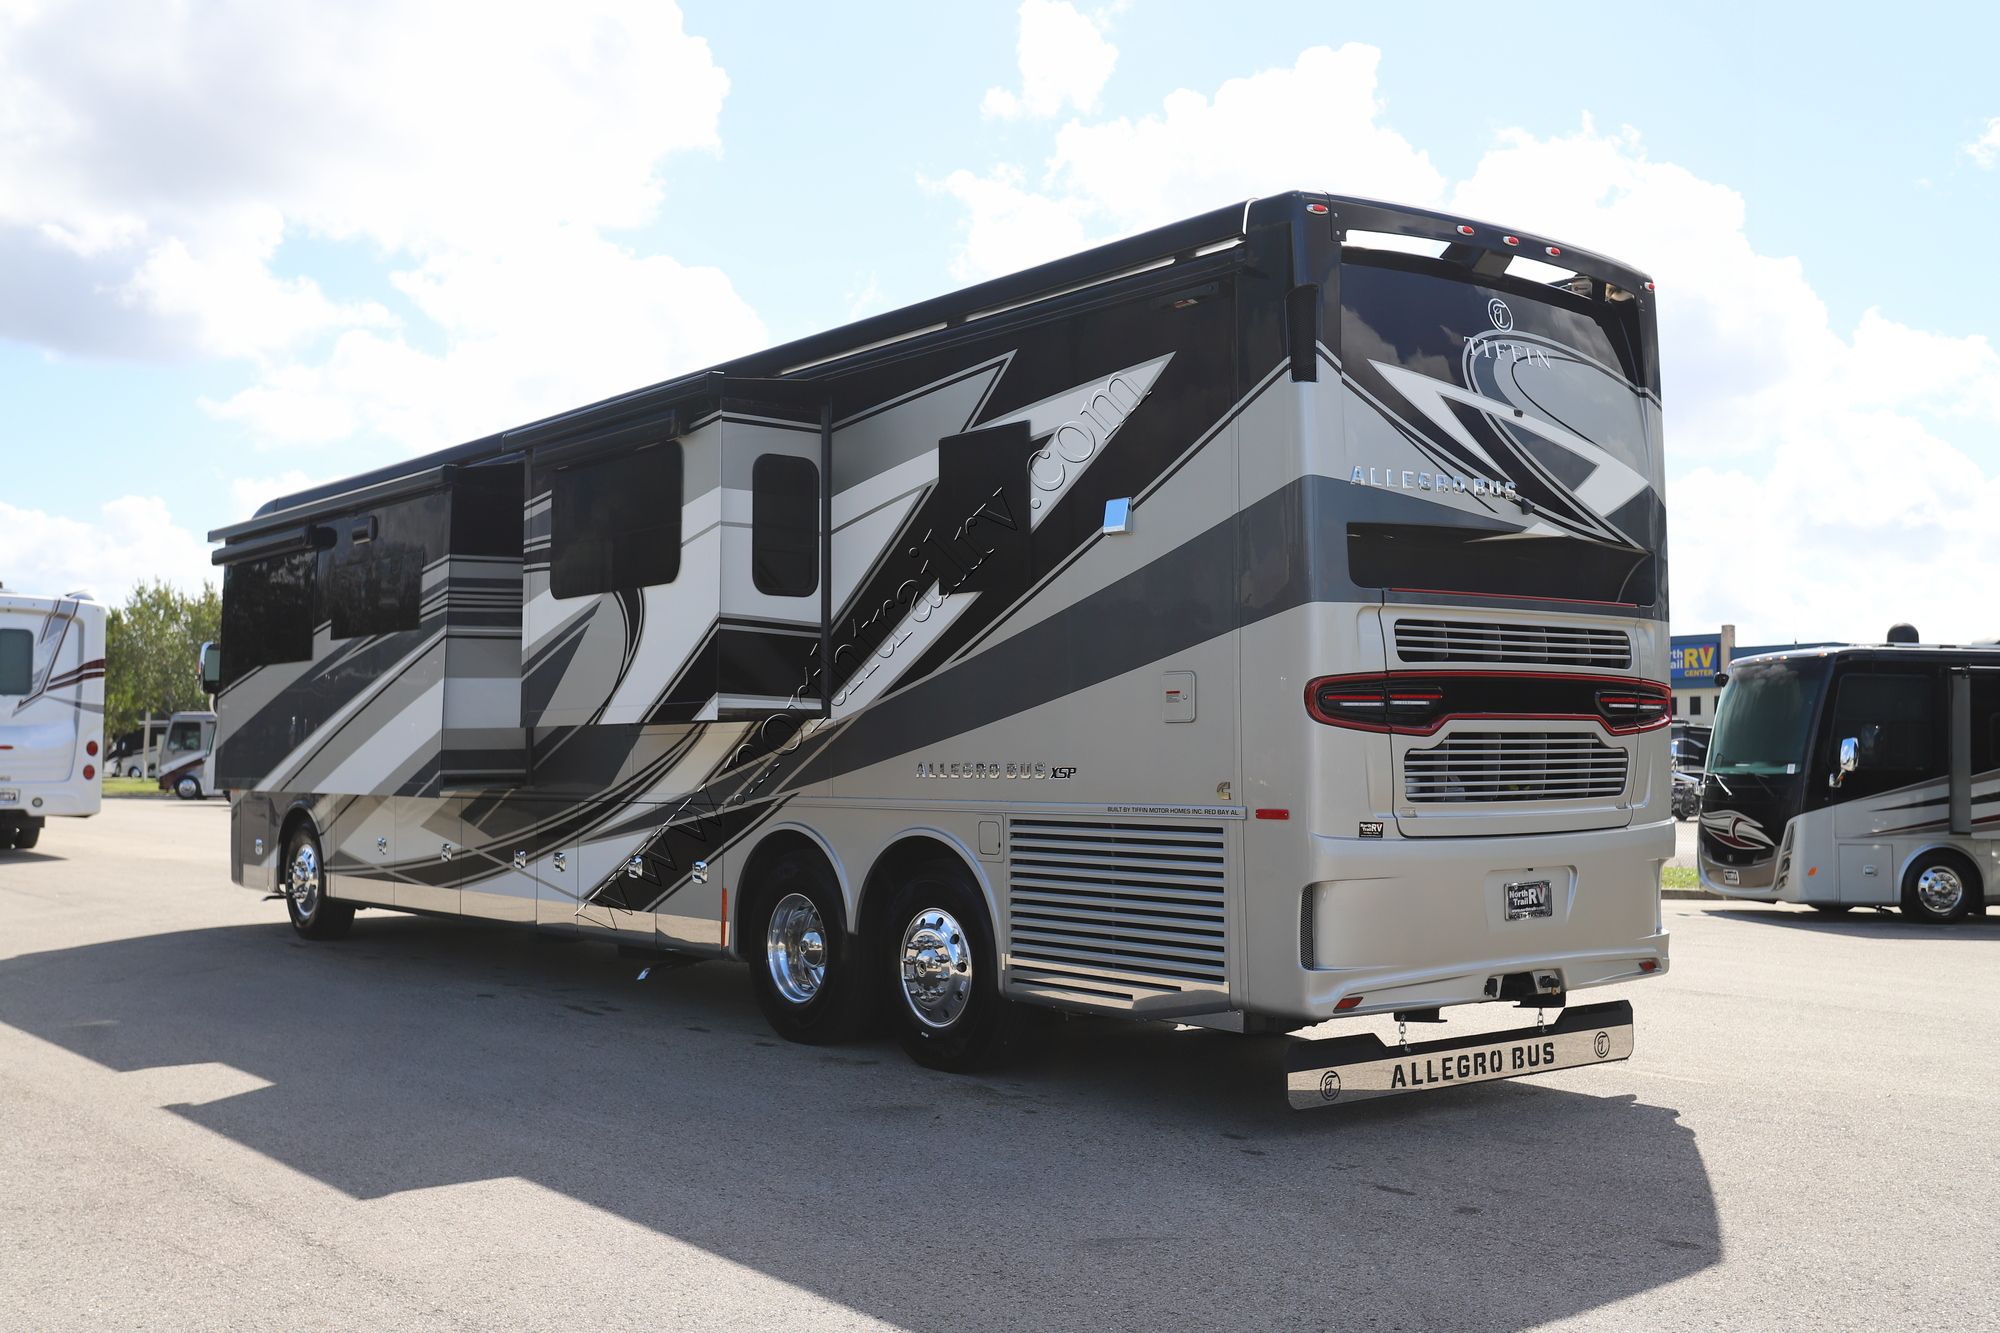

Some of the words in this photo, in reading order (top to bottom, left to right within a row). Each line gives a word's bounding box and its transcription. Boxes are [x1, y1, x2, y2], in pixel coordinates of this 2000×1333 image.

[1463, 336, 1551, 369] TIFFIN
[1350, 465, 1466, 495] ALLEGRO
[1472, 477, 1518, 500] BUS
[1684, 646, 1715, 669] RV
[916, 762, 1000, 779] ALLEGRO
[1006, 762, 1046, 779] BUS
[1050, 767, 1077, 779] XSP
[1371, 823, 1383, 832] RV
[1509, 889, 1528, 898] North
[1513, 897, 1529, 905] Trail
[1528, 887, 1546, 904] RV
[1391, 1050, 1503, 1089] ALLEGRO
[1512, 1042, 1555, 1070] BUS
